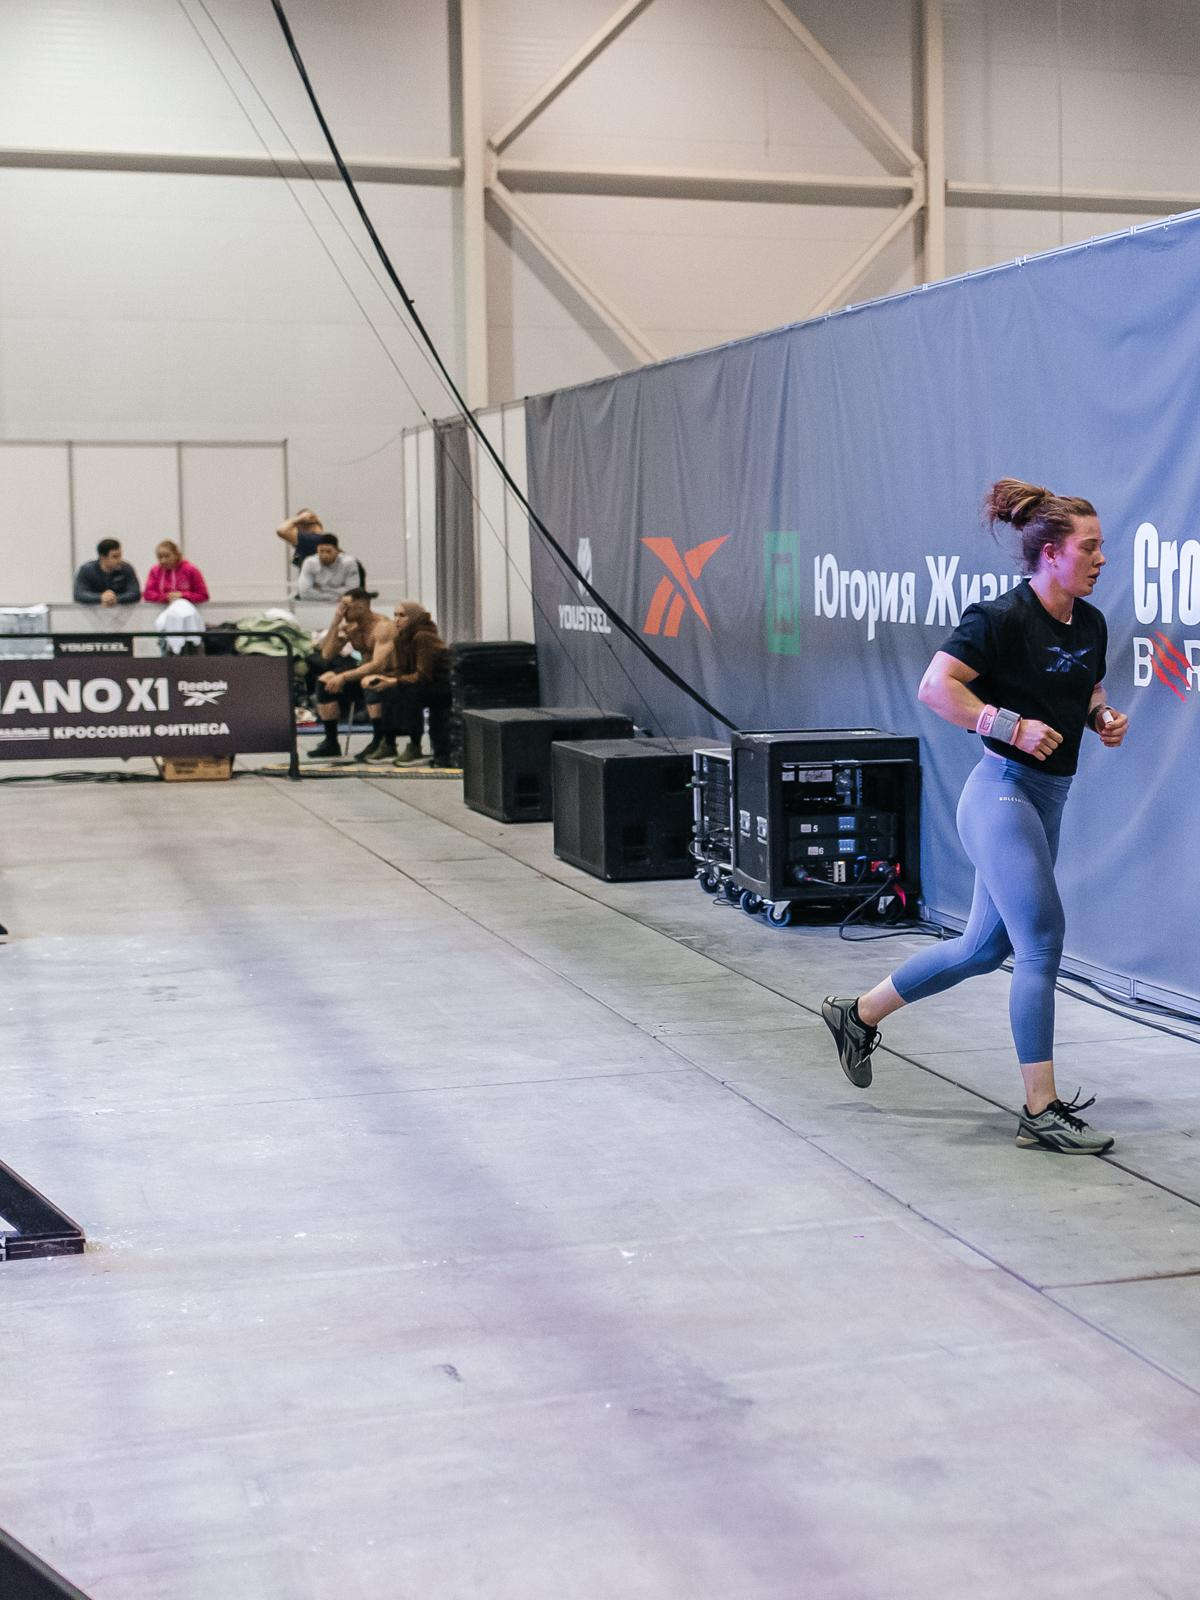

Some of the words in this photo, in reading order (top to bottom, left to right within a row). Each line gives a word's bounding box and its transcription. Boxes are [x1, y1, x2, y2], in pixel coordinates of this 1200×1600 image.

[814, 553, 916, 642] Югория
[924, 555, 1033, 627] Жиз
[558, 604, 612, 634] YOUSTEEL
[58, 641, 129, 653] YOUSTEEL
[177, 680, 229, 693] Reebok
[0, 677, 123, 715] ANO
[126, 677, 170, 712] X1
[53, 724, 151, 740] КРОССОВКИ
[154, 722, 230, 737] ФИТНЕСА
[812, 824, 819, 833] 5
